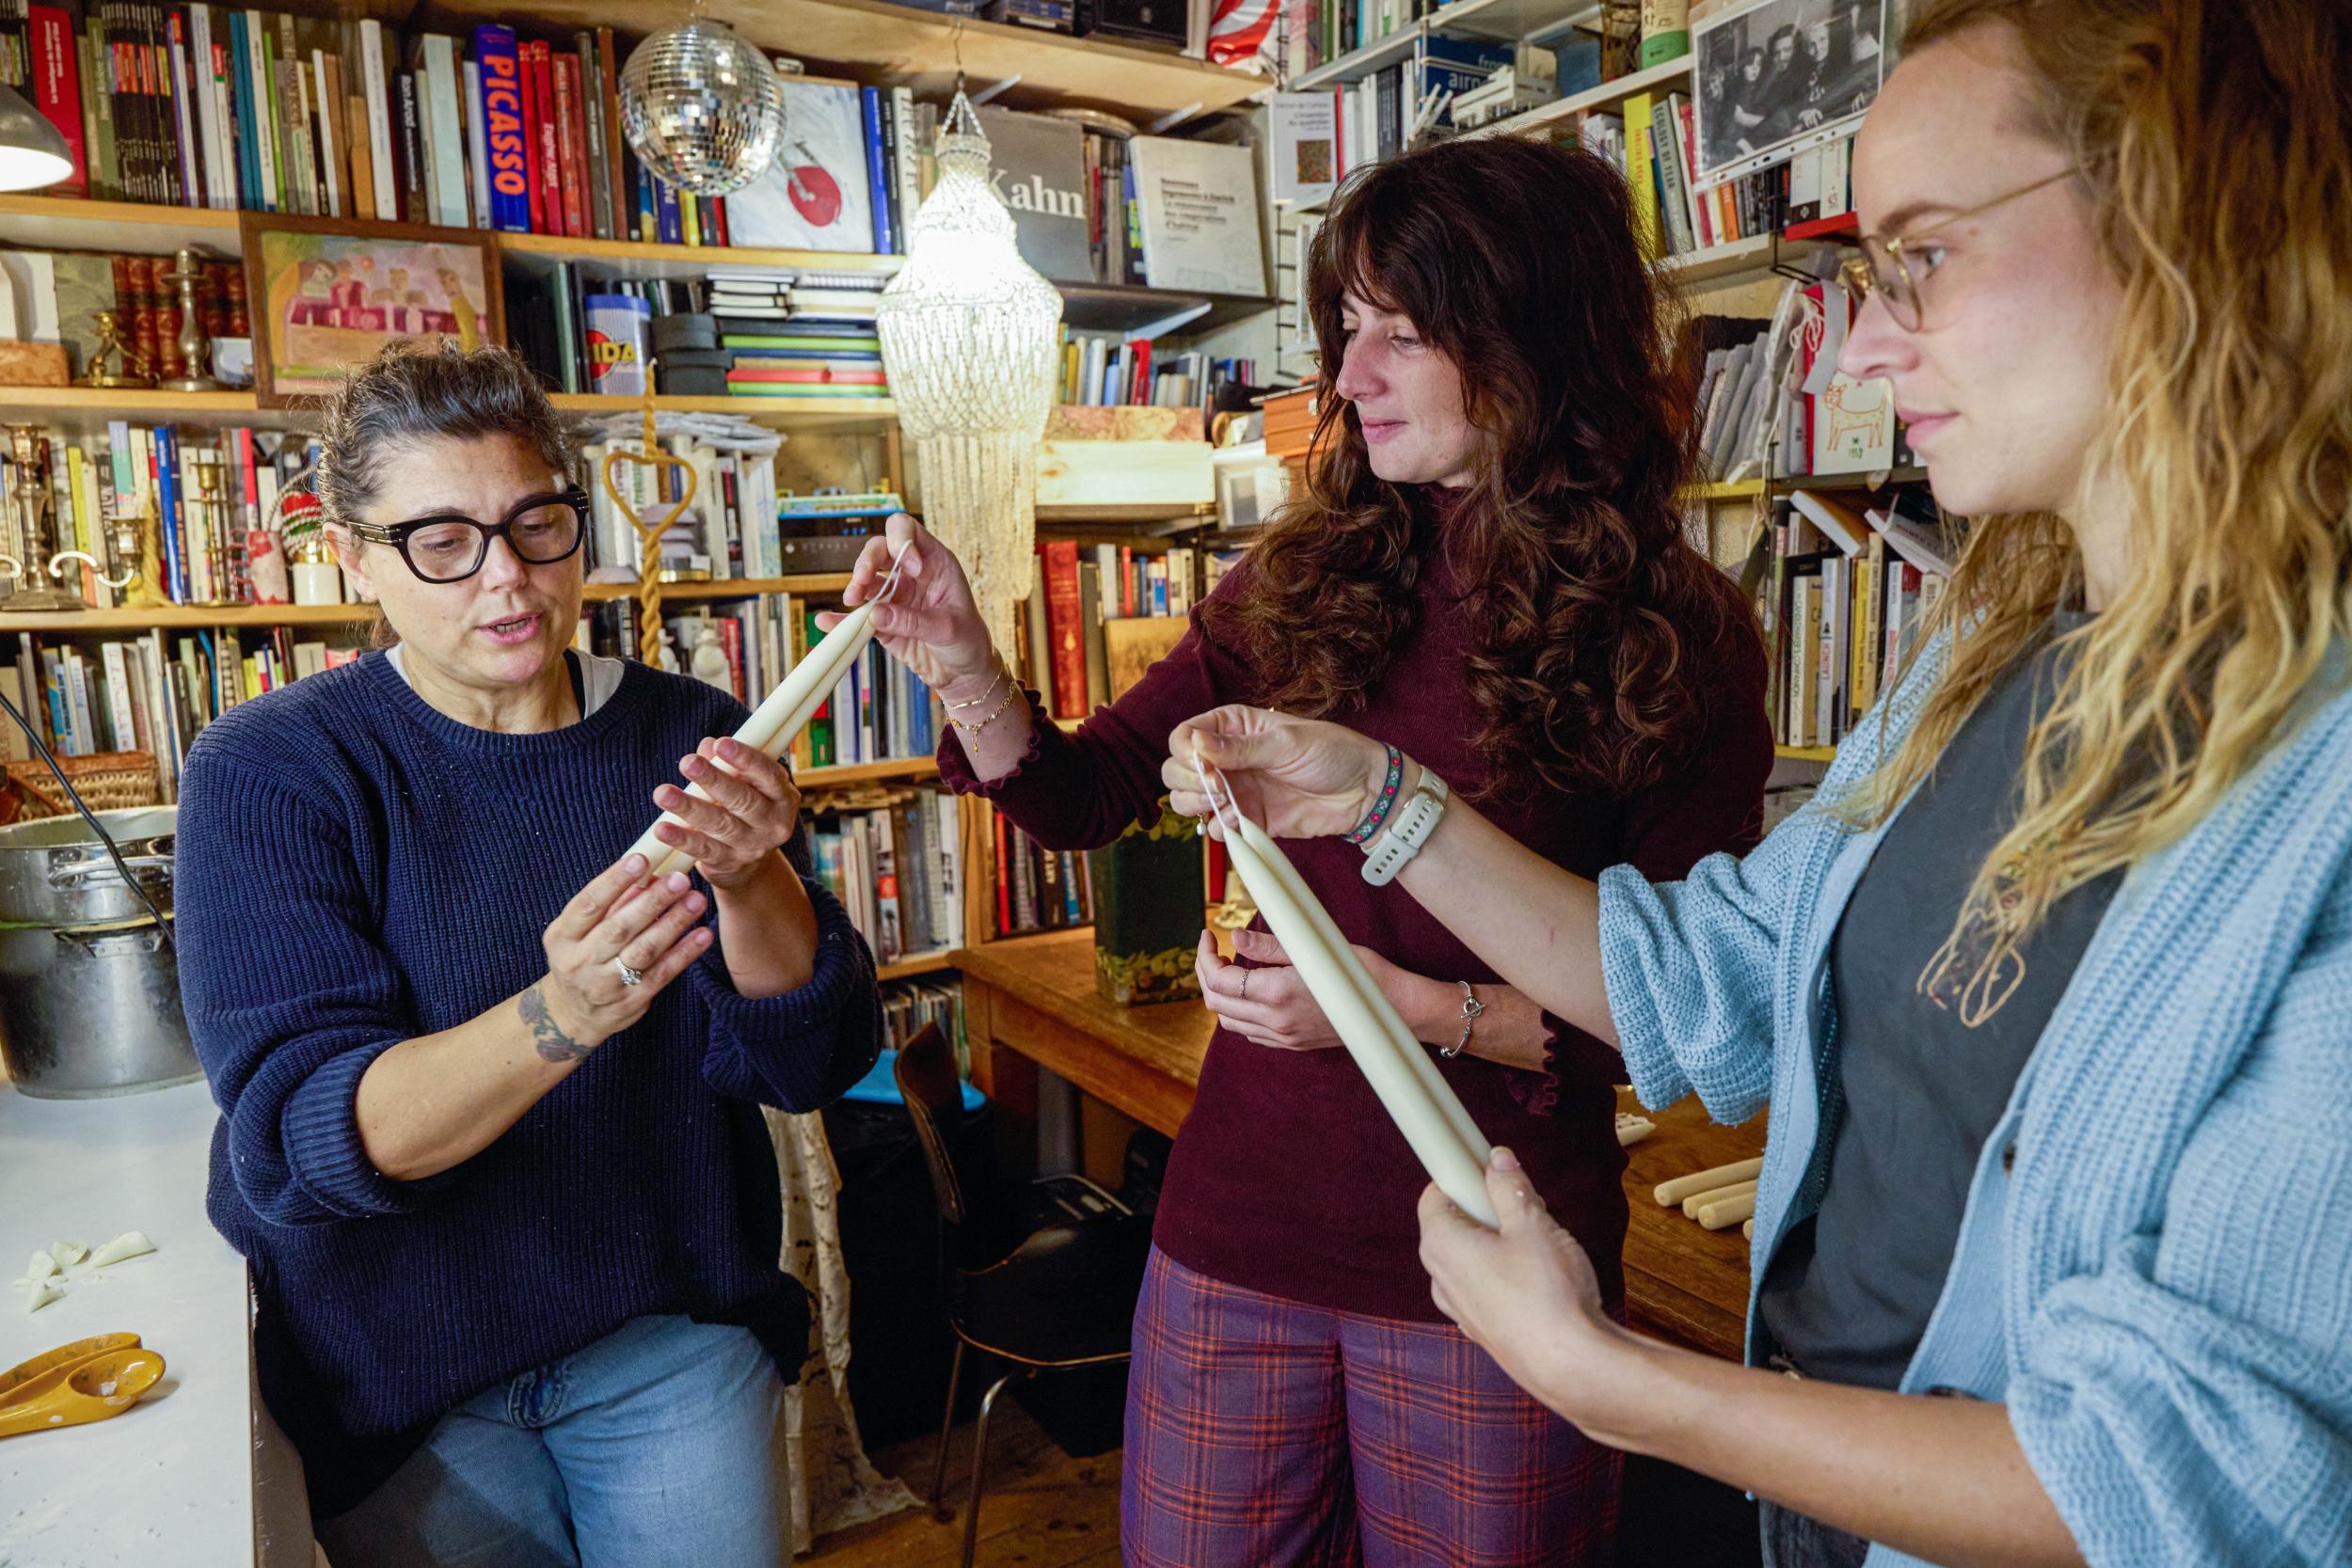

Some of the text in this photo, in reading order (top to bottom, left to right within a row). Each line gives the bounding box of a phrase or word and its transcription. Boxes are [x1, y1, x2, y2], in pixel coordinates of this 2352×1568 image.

[401, 74, 412, 98] Ron
[484, 55, 526, 196] PICASSO
[1653, 106, 1669, 148] ECOLOGY
[1661, 150, 1671, 161] OF
[987, 167, 1086, 218] Kahn
[1663, 165, 1677, 189] FEAR
[1820, 641, 1831, 680] LAUNCH
